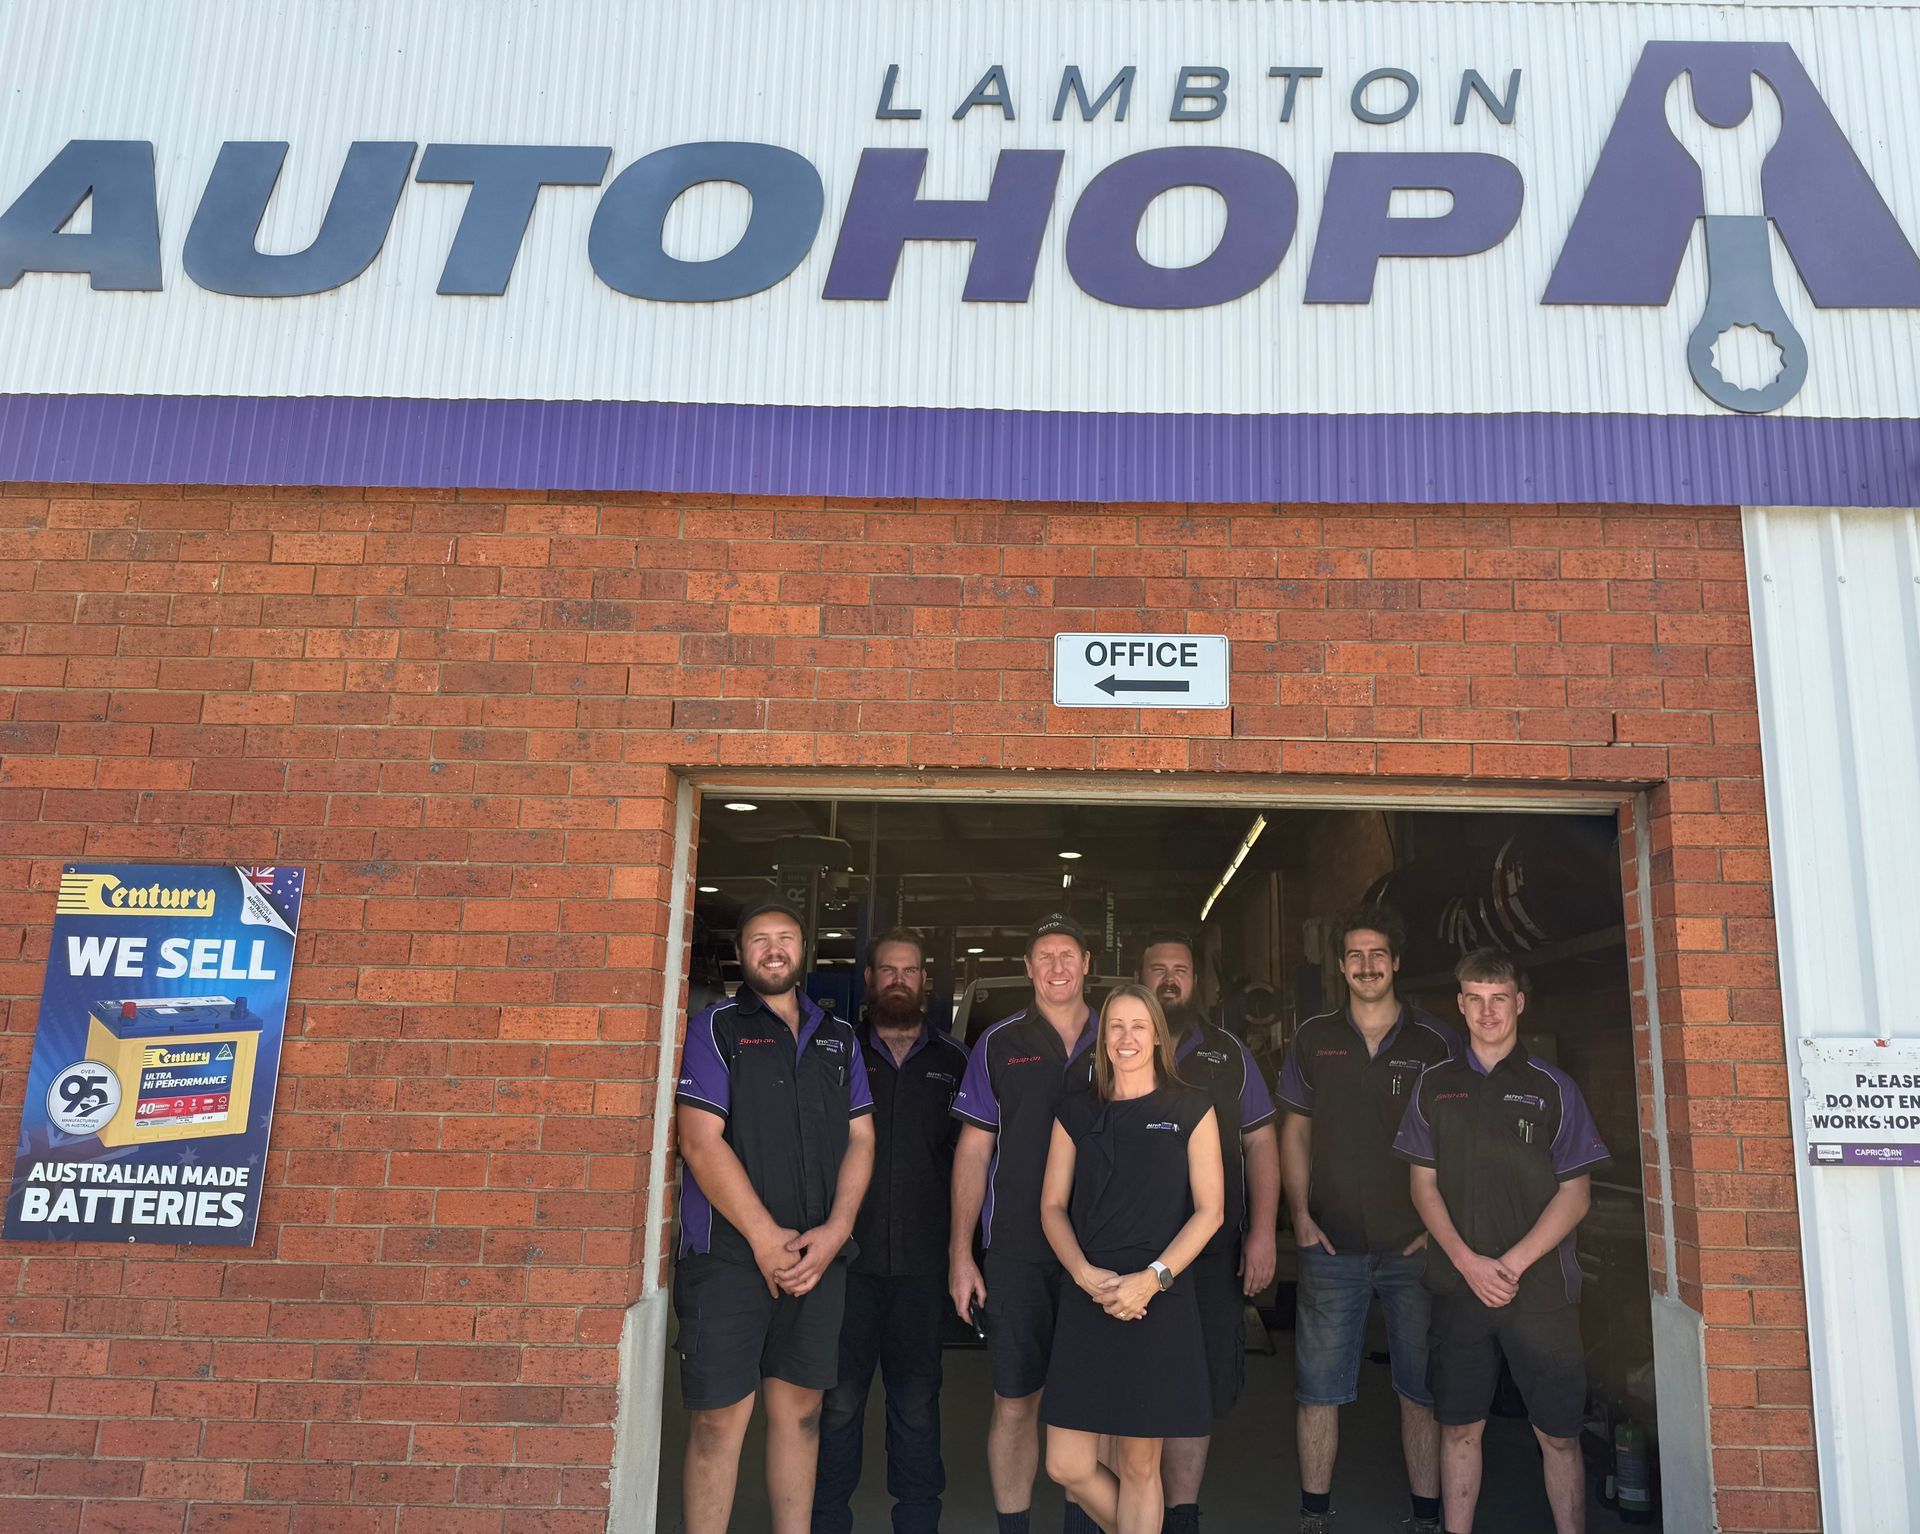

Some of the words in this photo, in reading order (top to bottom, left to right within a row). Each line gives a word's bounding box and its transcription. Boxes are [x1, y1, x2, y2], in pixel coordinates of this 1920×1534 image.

[876, 64, 1522, 125] LAMBTON
[1085, 641, 1198, 667] OFFICE
[80, 874, 216, 917] Century
[254, 895, 272, 915] PROUDLY
[247, 896, 271, 923] AUSTRALIAN
[248, 905, 261, 920] MADE
[68, 936, 147, 977] WE
[156, 938, 276, 980] SELL
[150, 1049, 210, 1068] Century
[143, 1080, 154, 1089] Hi
[155, 1075, 227, 1089] PERFORMANCE
[145, 1072, 172, 1081] ULTRA
[1856, 1074, 1920, 1088] PLEASE
[59, 1075, 108, 1113] 95
[1826, 1095, 1852, 1108] DO
[1856, 1095, 1894, 1108] NOT
[138, 1103, 155, 1114] 40
[1812, 1115, 1920, 1129] WORKSHOP
[28, 1162, 176, 1185] AUSTRALIAN
[182, 1166, 250, 1187] MADE
[20, 1188, 246, 1228] BATTERIES
